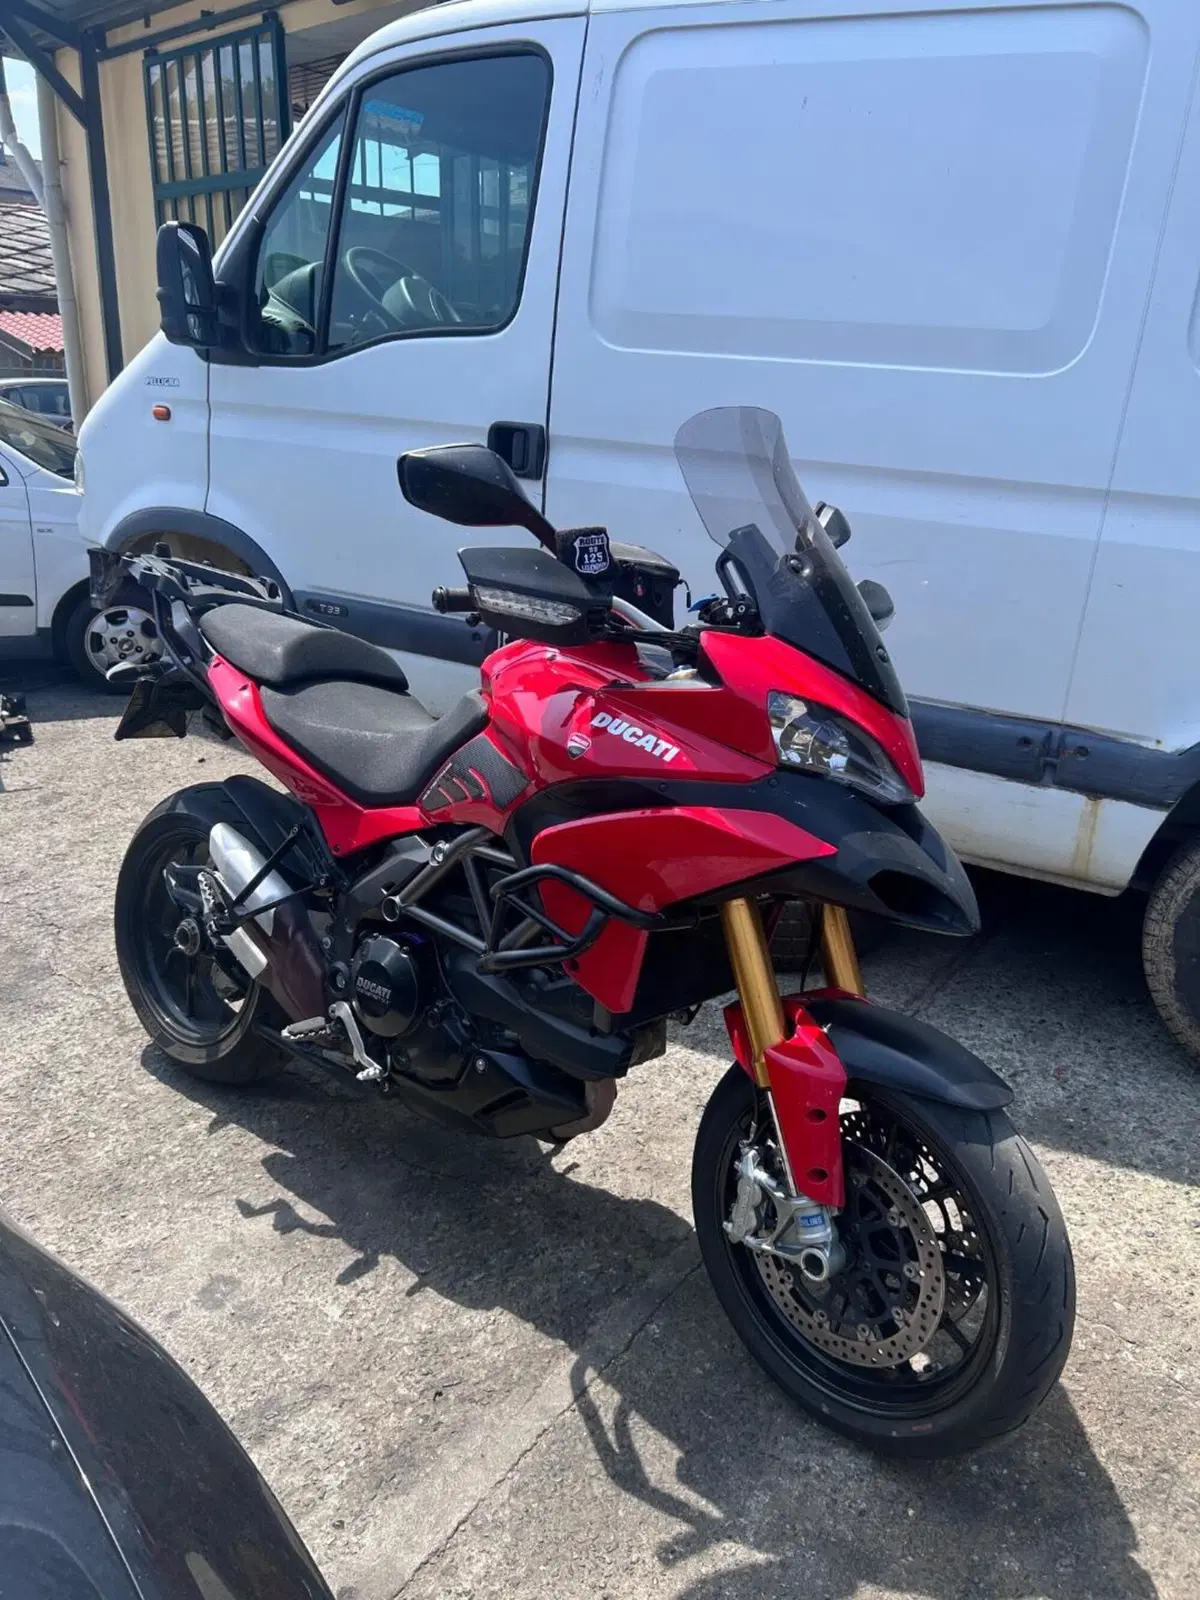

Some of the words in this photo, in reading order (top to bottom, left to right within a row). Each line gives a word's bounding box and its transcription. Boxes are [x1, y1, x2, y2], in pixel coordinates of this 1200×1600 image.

[579, 536, 605, 546] ROUTE
[583, 552, 603, 564] 125
[319, 603, 340, 615] T33
[590, 711, 681, 763] DUCATI
[356, 976, 392, 1000] DUCATI
